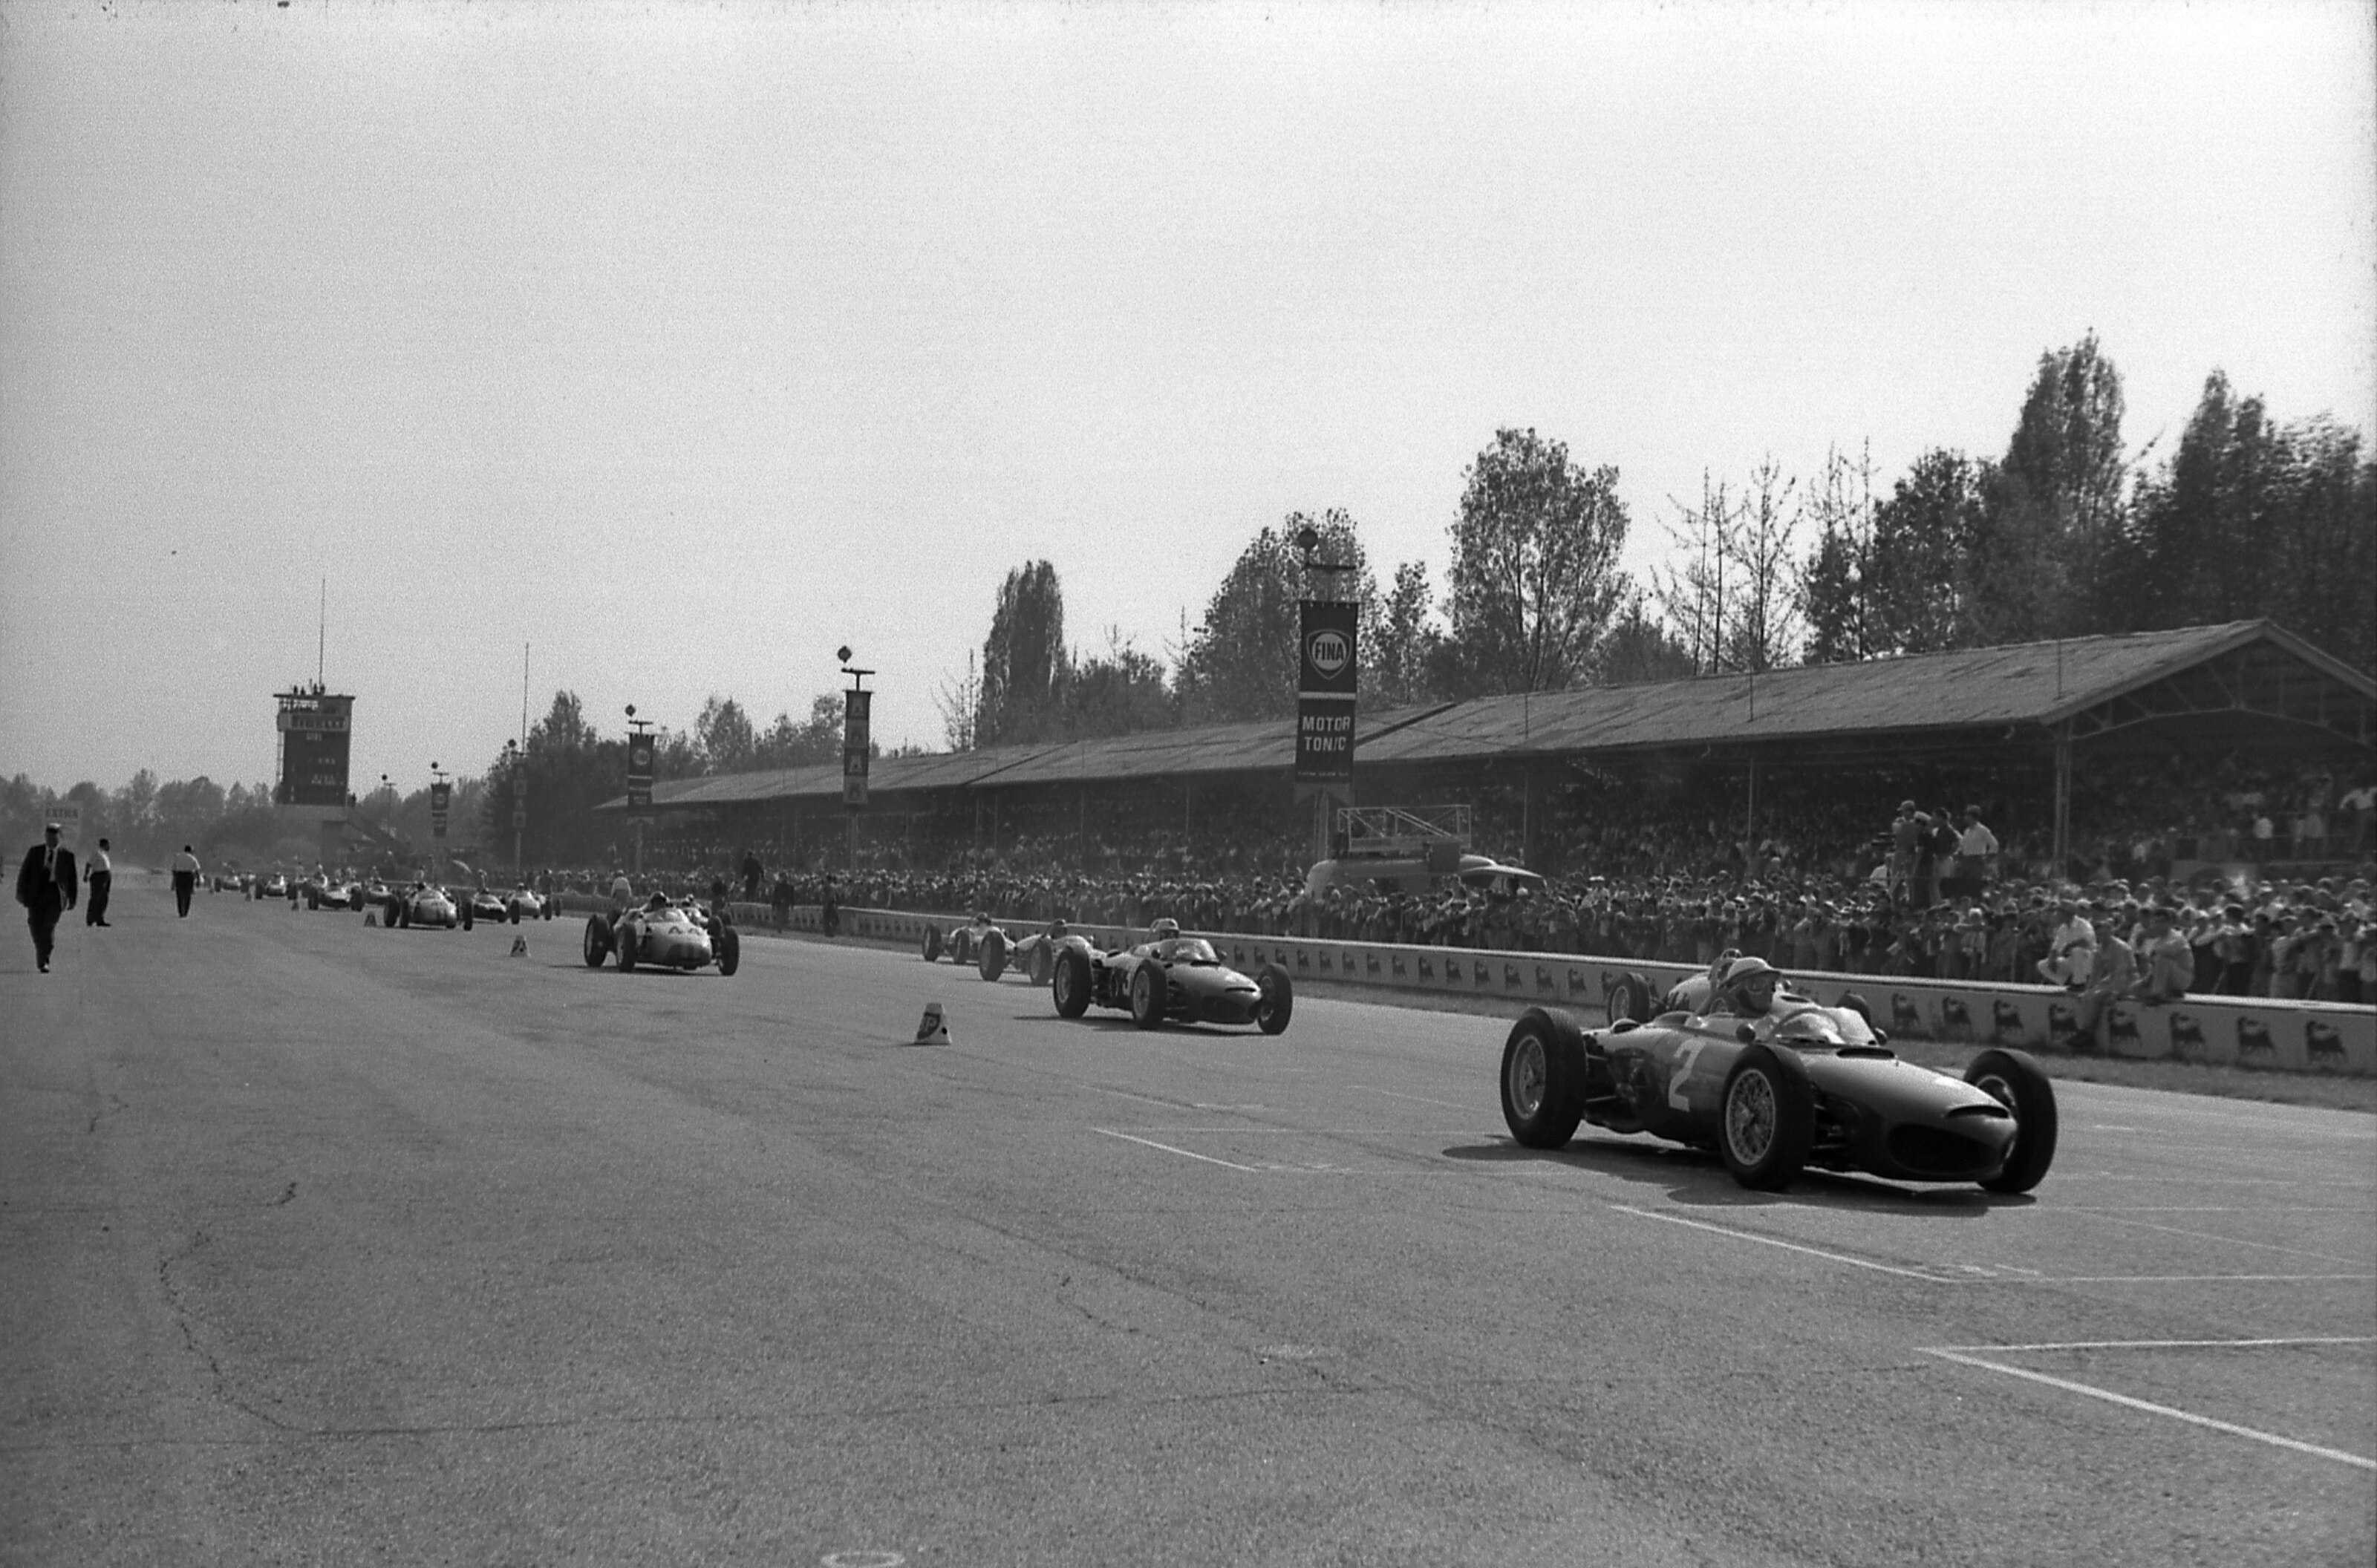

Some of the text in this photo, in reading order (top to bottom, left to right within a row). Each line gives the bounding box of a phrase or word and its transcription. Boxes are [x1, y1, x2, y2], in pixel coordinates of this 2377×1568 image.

[1315, 642, 1345, 661] FINA
[1302, 716, 1351, 731] MOTOR
[1304, 736, 1346, 751] TONIC
[1668, 1039, 1706, 1113] 2
